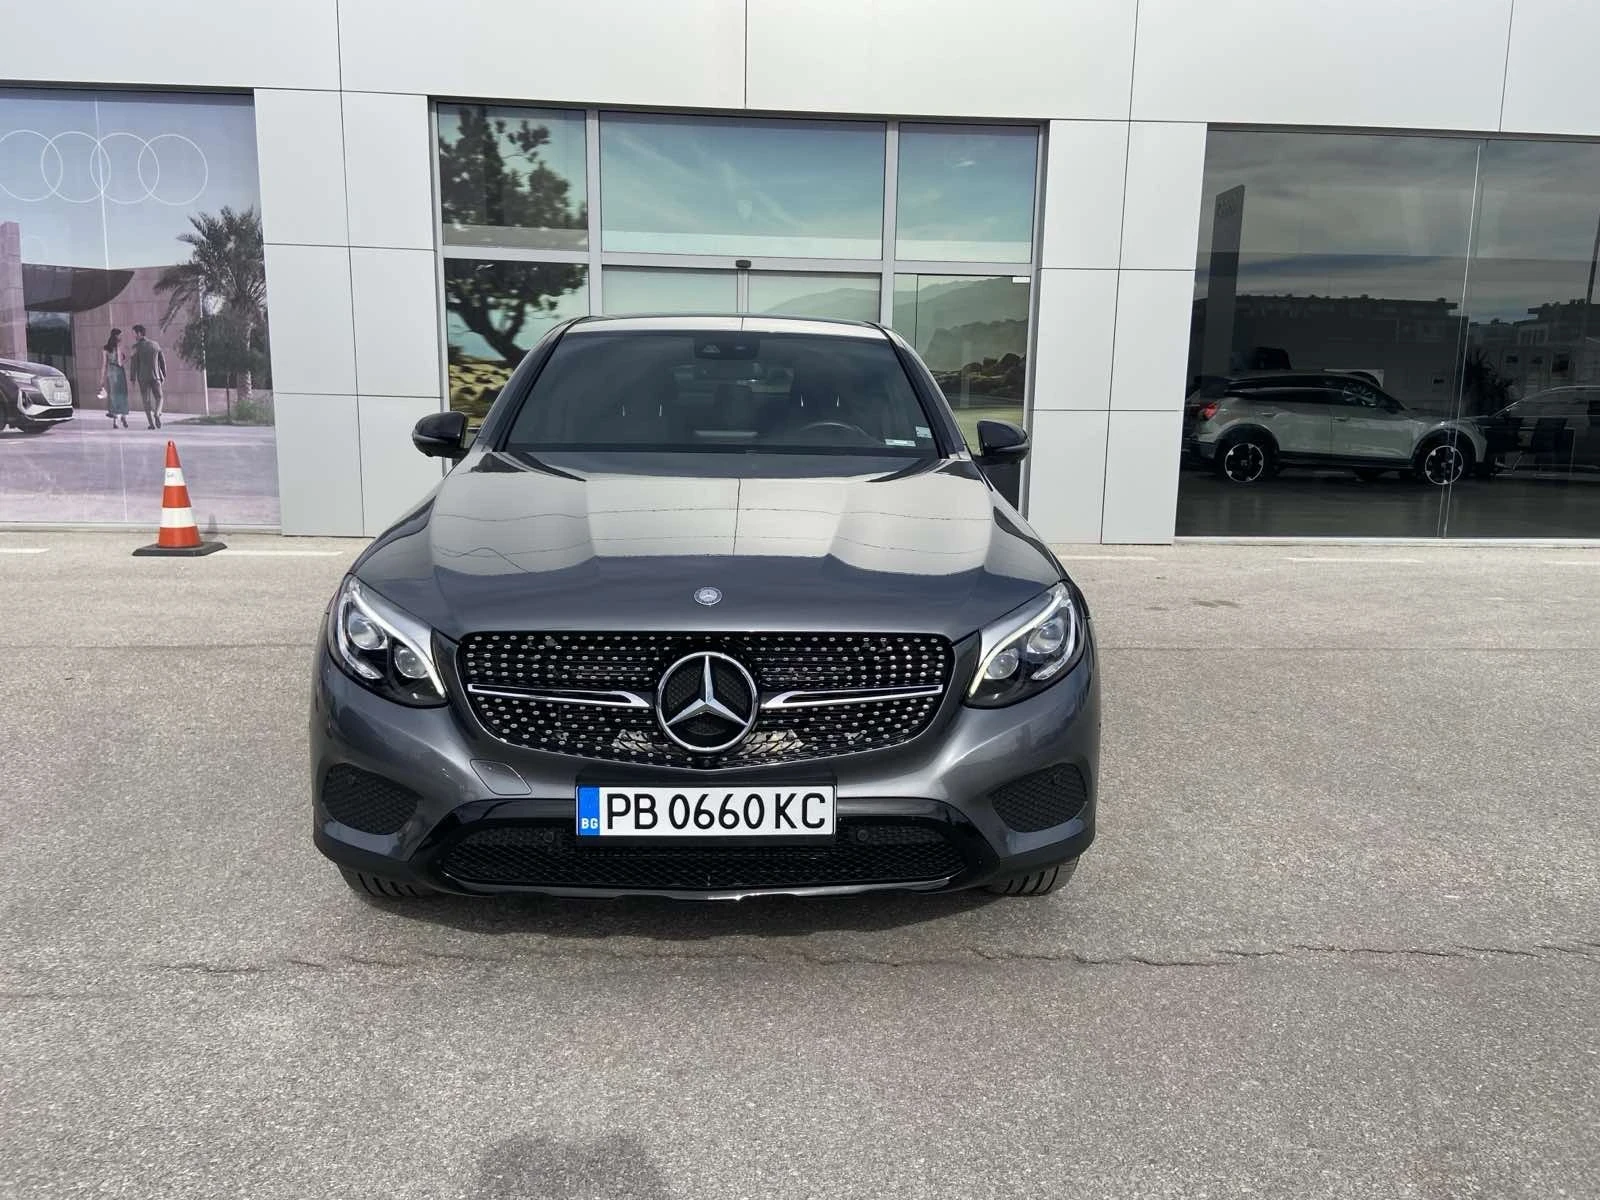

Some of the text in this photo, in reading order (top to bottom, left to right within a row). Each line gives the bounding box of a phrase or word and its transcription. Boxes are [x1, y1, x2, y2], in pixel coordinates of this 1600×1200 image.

[607, 792, 826, 830] PB 0660 KC
[581, 818, 598, 829] BG
